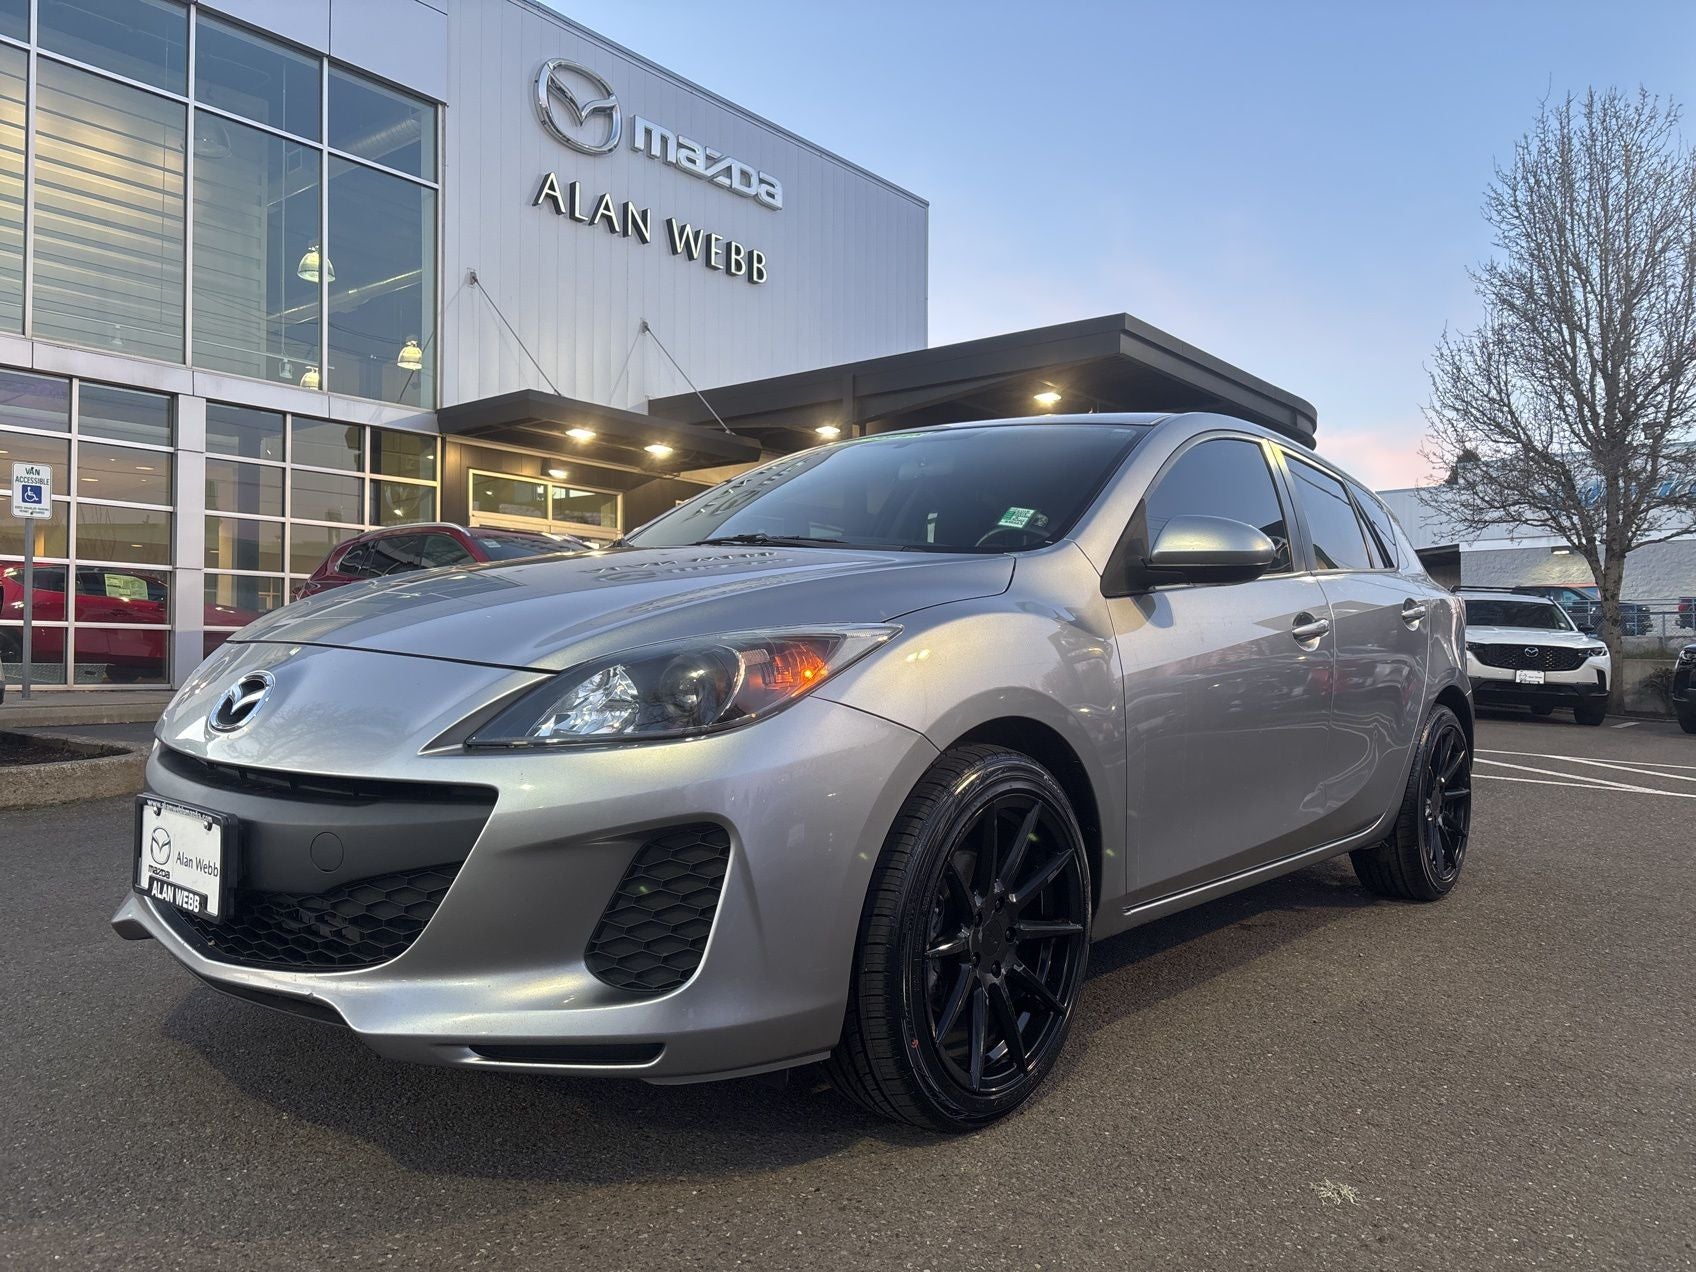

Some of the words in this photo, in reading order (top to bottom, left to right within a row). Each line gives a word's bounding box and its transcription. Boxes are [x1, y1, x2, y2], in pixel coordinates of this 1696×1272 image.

[630, 115, 783, 210] mazda
[532, 172, 651, 244] ALAN
[666, 217, 767, 284] WEBB
[15, 476, 49, 485] ACCESSIBLE
[25, 467, 40, 476] VAN
[148, 864, 170, 879] mazda
[176, 851, 193, 869] Alan
[195, 856, 218, 877] Webb
[151, 880, 174, 903] ALAN
[175, 888, 200, 913] WEBB
